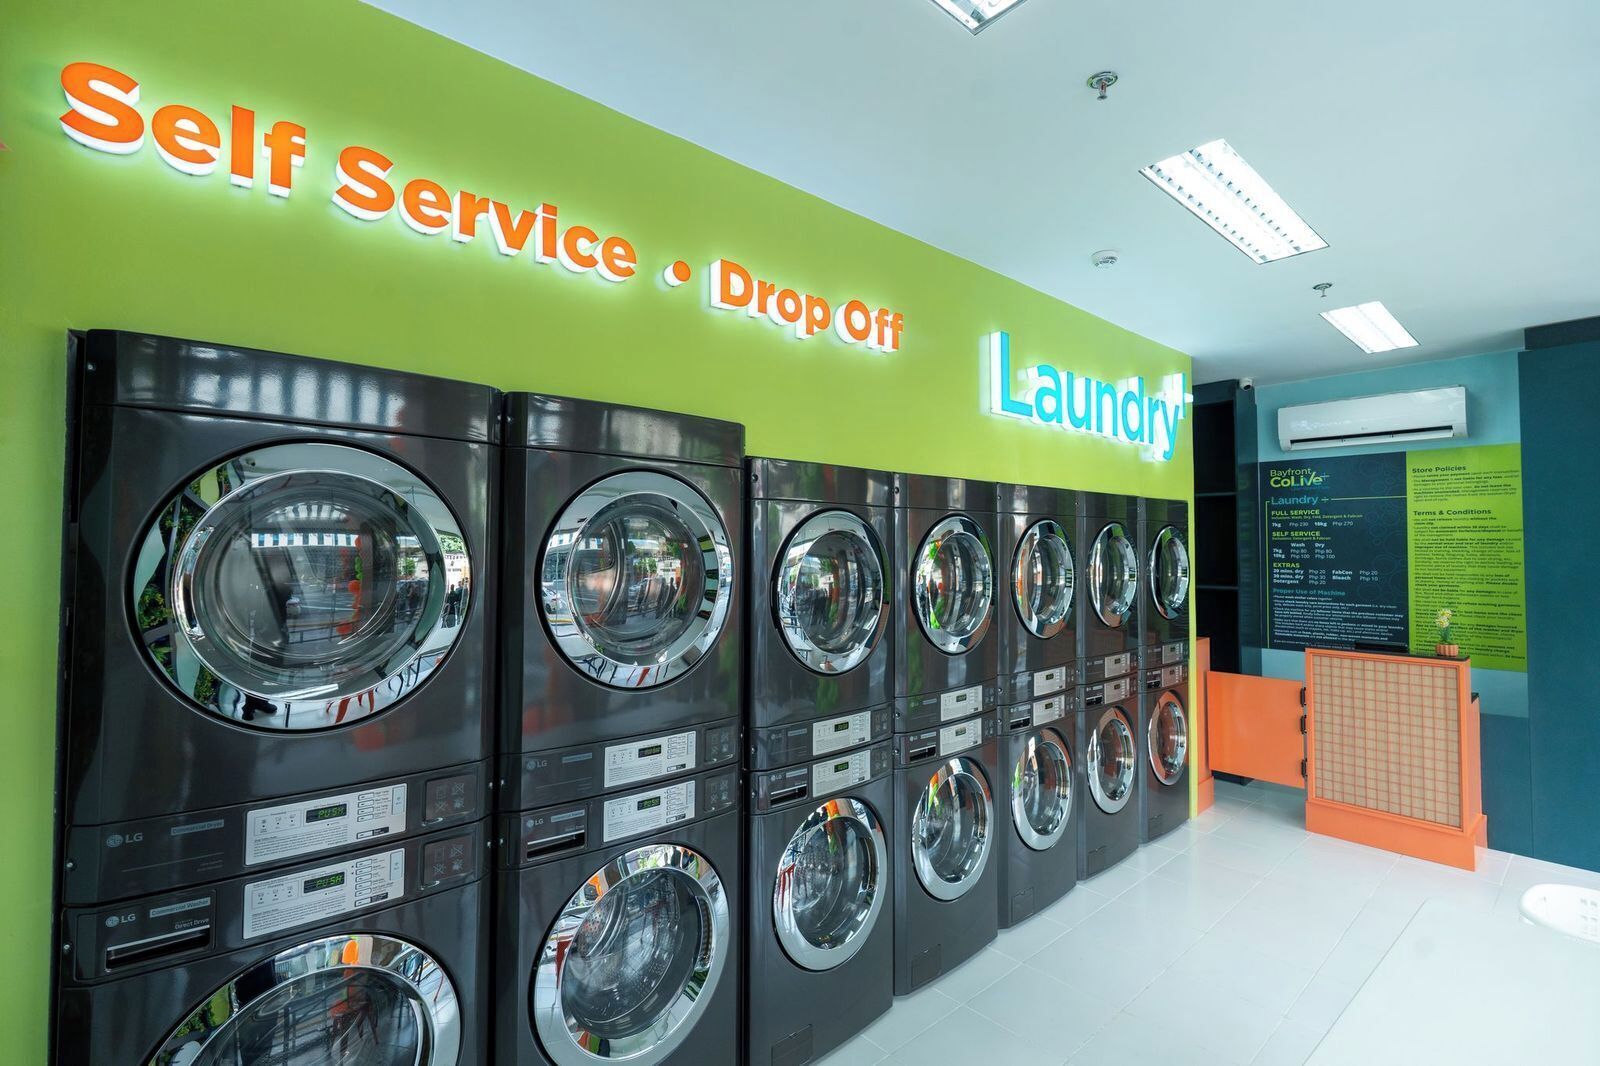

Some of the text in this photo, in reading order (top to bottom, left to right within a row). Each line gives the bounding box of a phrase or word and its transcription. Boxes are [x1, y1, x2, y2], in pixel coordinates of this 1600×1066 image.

[59, 62, 904, 352] Self Service Drop Off
[1270, 467, 1312, 478] Bayfront
[1435, 465, 1466, 473] Policies
[1271, 495, 1319, 506] Laundry
[537, 760, 548, 768] LG
[318, 806, 344, 818] PUSH
[125, 832, 144, 844] LG
[316, 874, 342, 888] PUSH
[121, 913, 136, 924] LG
[174, 922, 193, 930] Direct
[193, 918, 209, 926] Drive
